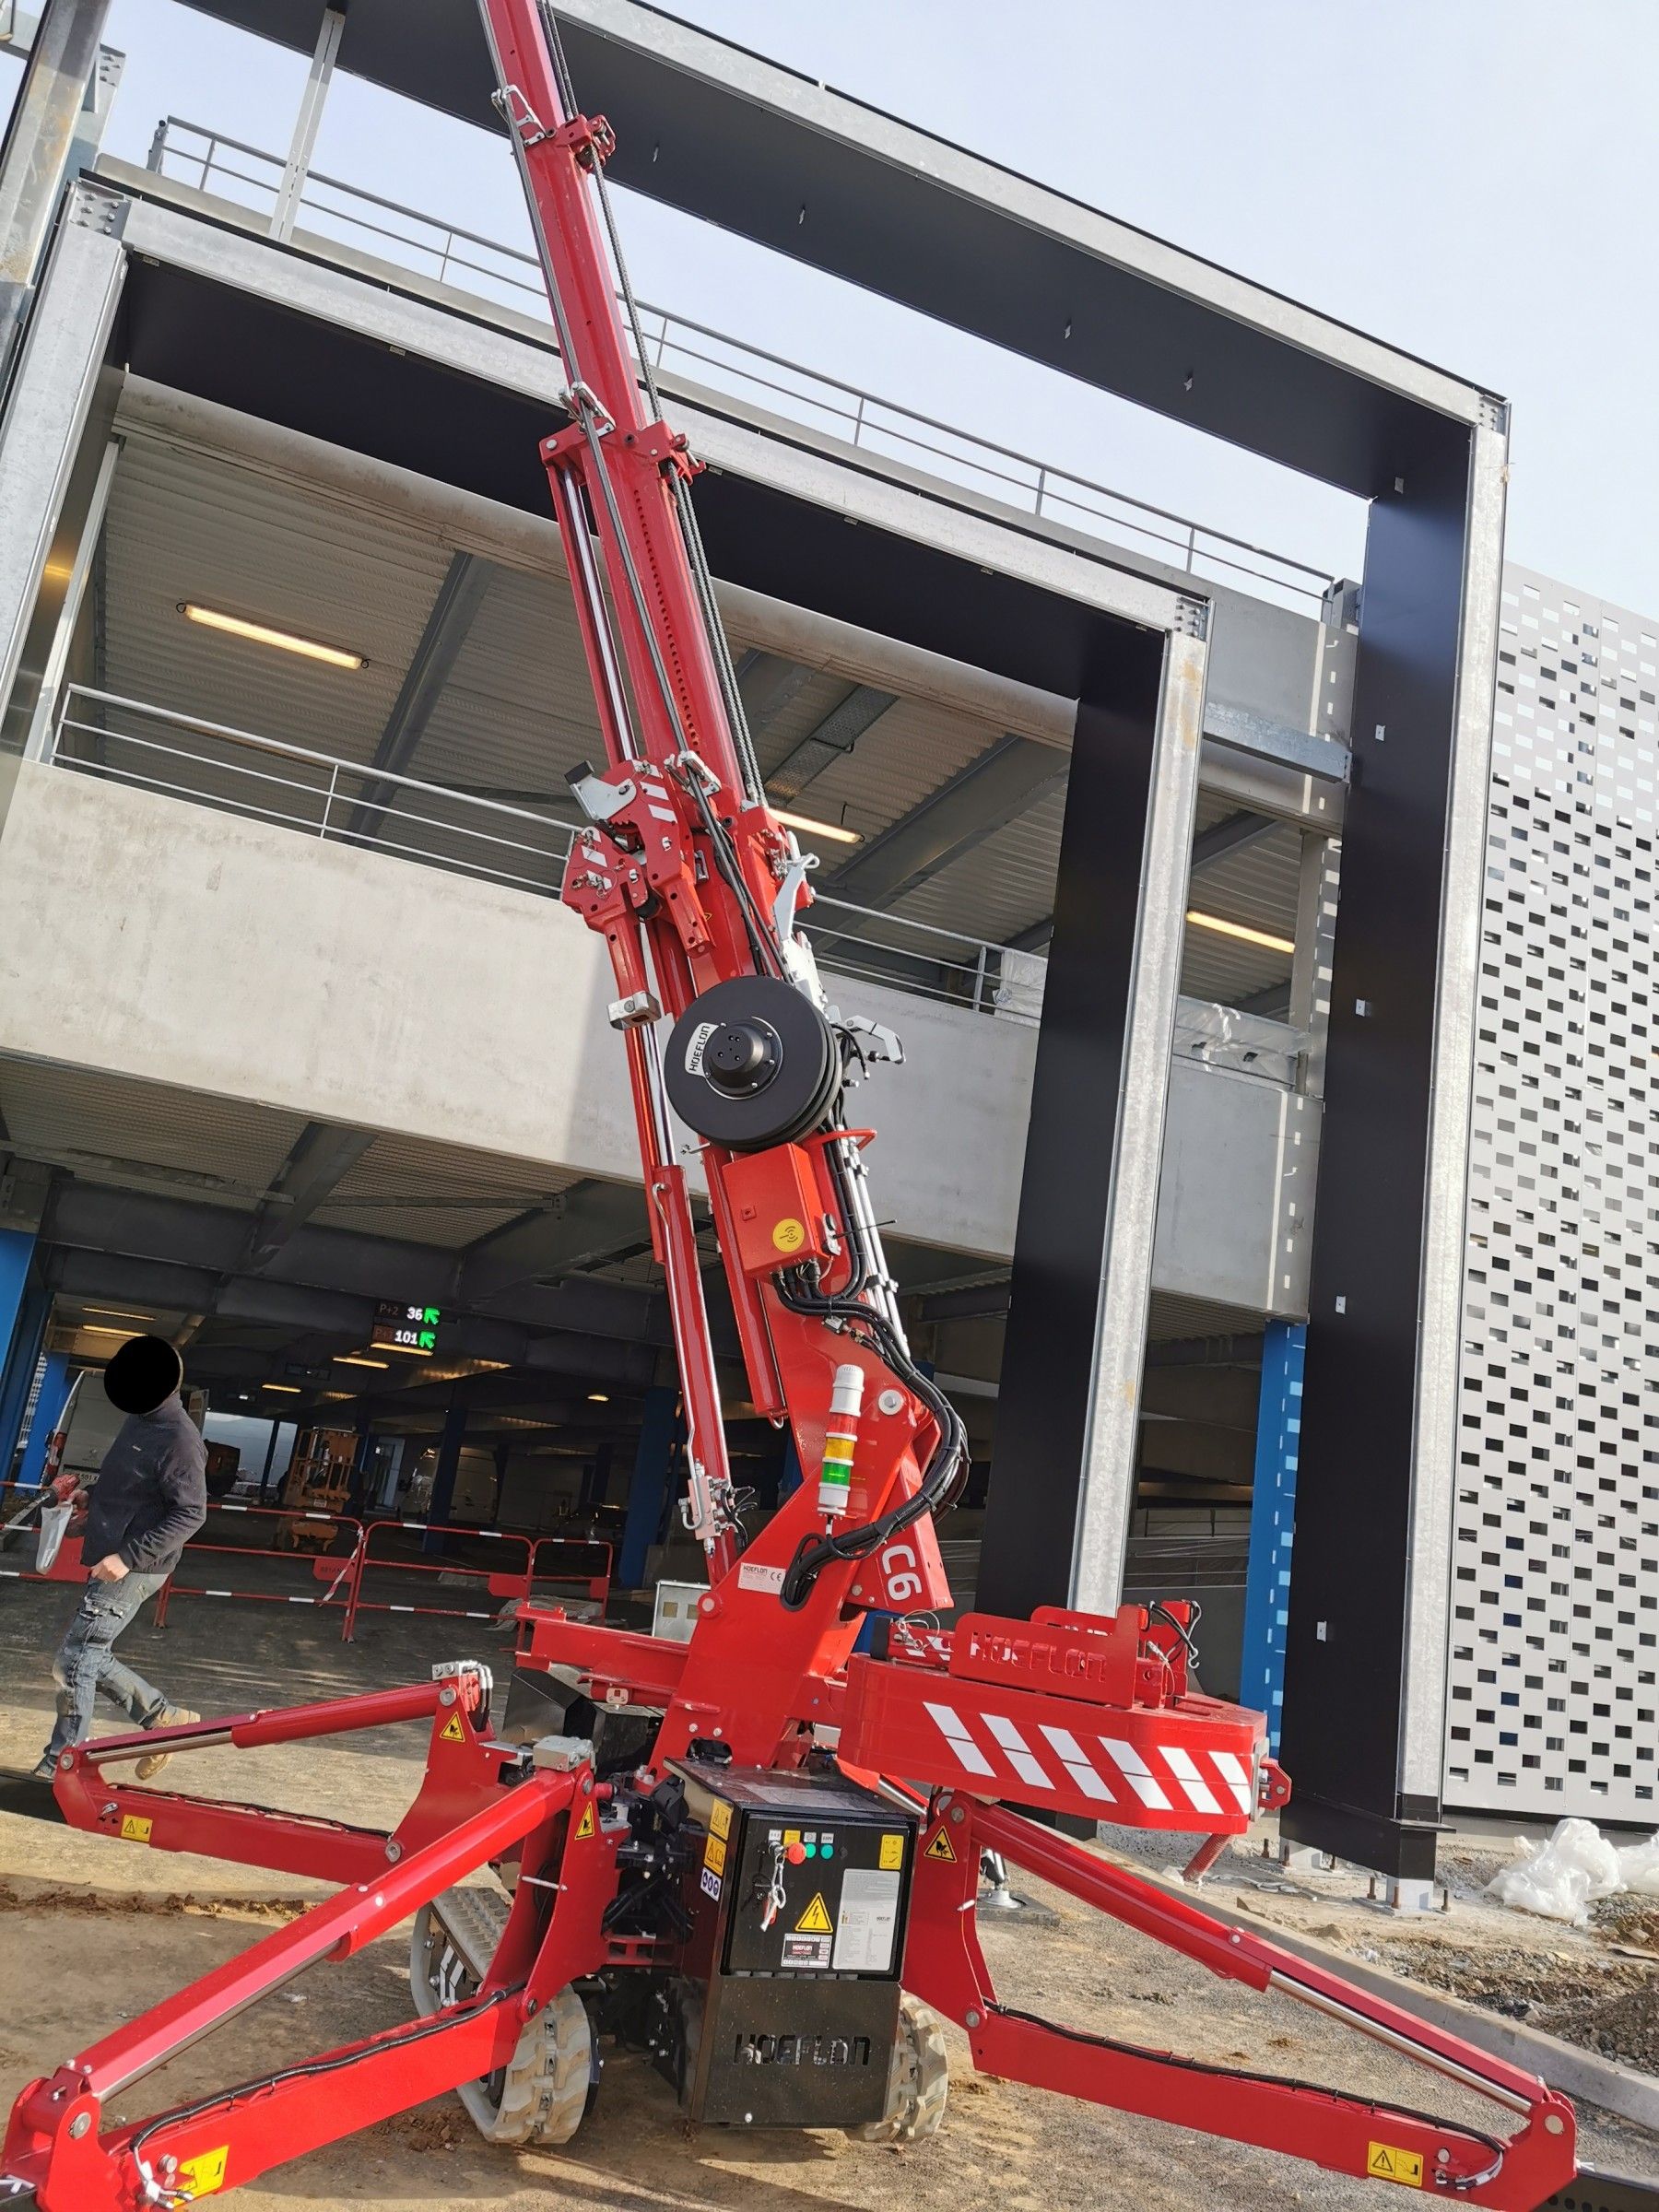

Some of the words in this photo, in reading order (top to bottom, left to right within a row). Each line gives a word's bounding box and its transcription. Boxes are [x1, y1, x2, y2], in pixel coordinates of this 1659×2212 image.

[688, 1025, 711, 1072] HOEFLON
[379, 1303, 399, 1316] P+2
[406, 1306, 423, 1321] 36
[394, 1329, 418, 1345] 101
[743, 1565, 768, 1574] HOEFLON
[882, 1545, 923, 1601] C6
[970, 1631, 1107, 1683] HOEFLON
[733, 2033, 871, 2065] HOEFLON
